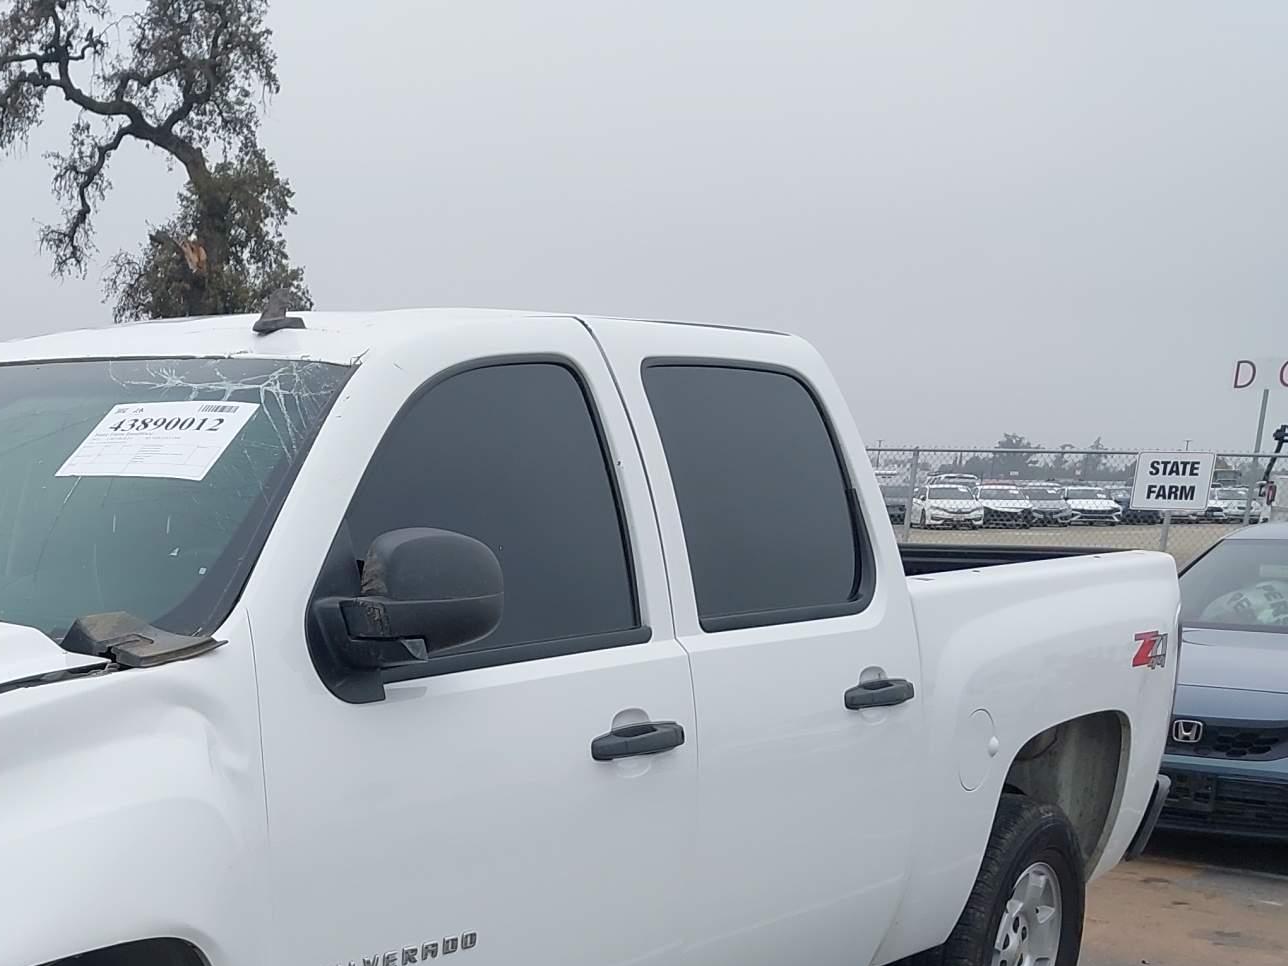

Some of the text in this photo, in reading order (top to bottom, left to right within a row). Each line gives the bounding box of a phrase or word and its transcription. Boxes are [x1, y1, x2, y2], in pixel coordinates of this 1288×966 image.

[109, 417, 225, 432] 43890012
[1148, 460, 1201, 477] STATE
[1146, 484, 1196, 501] FARM
